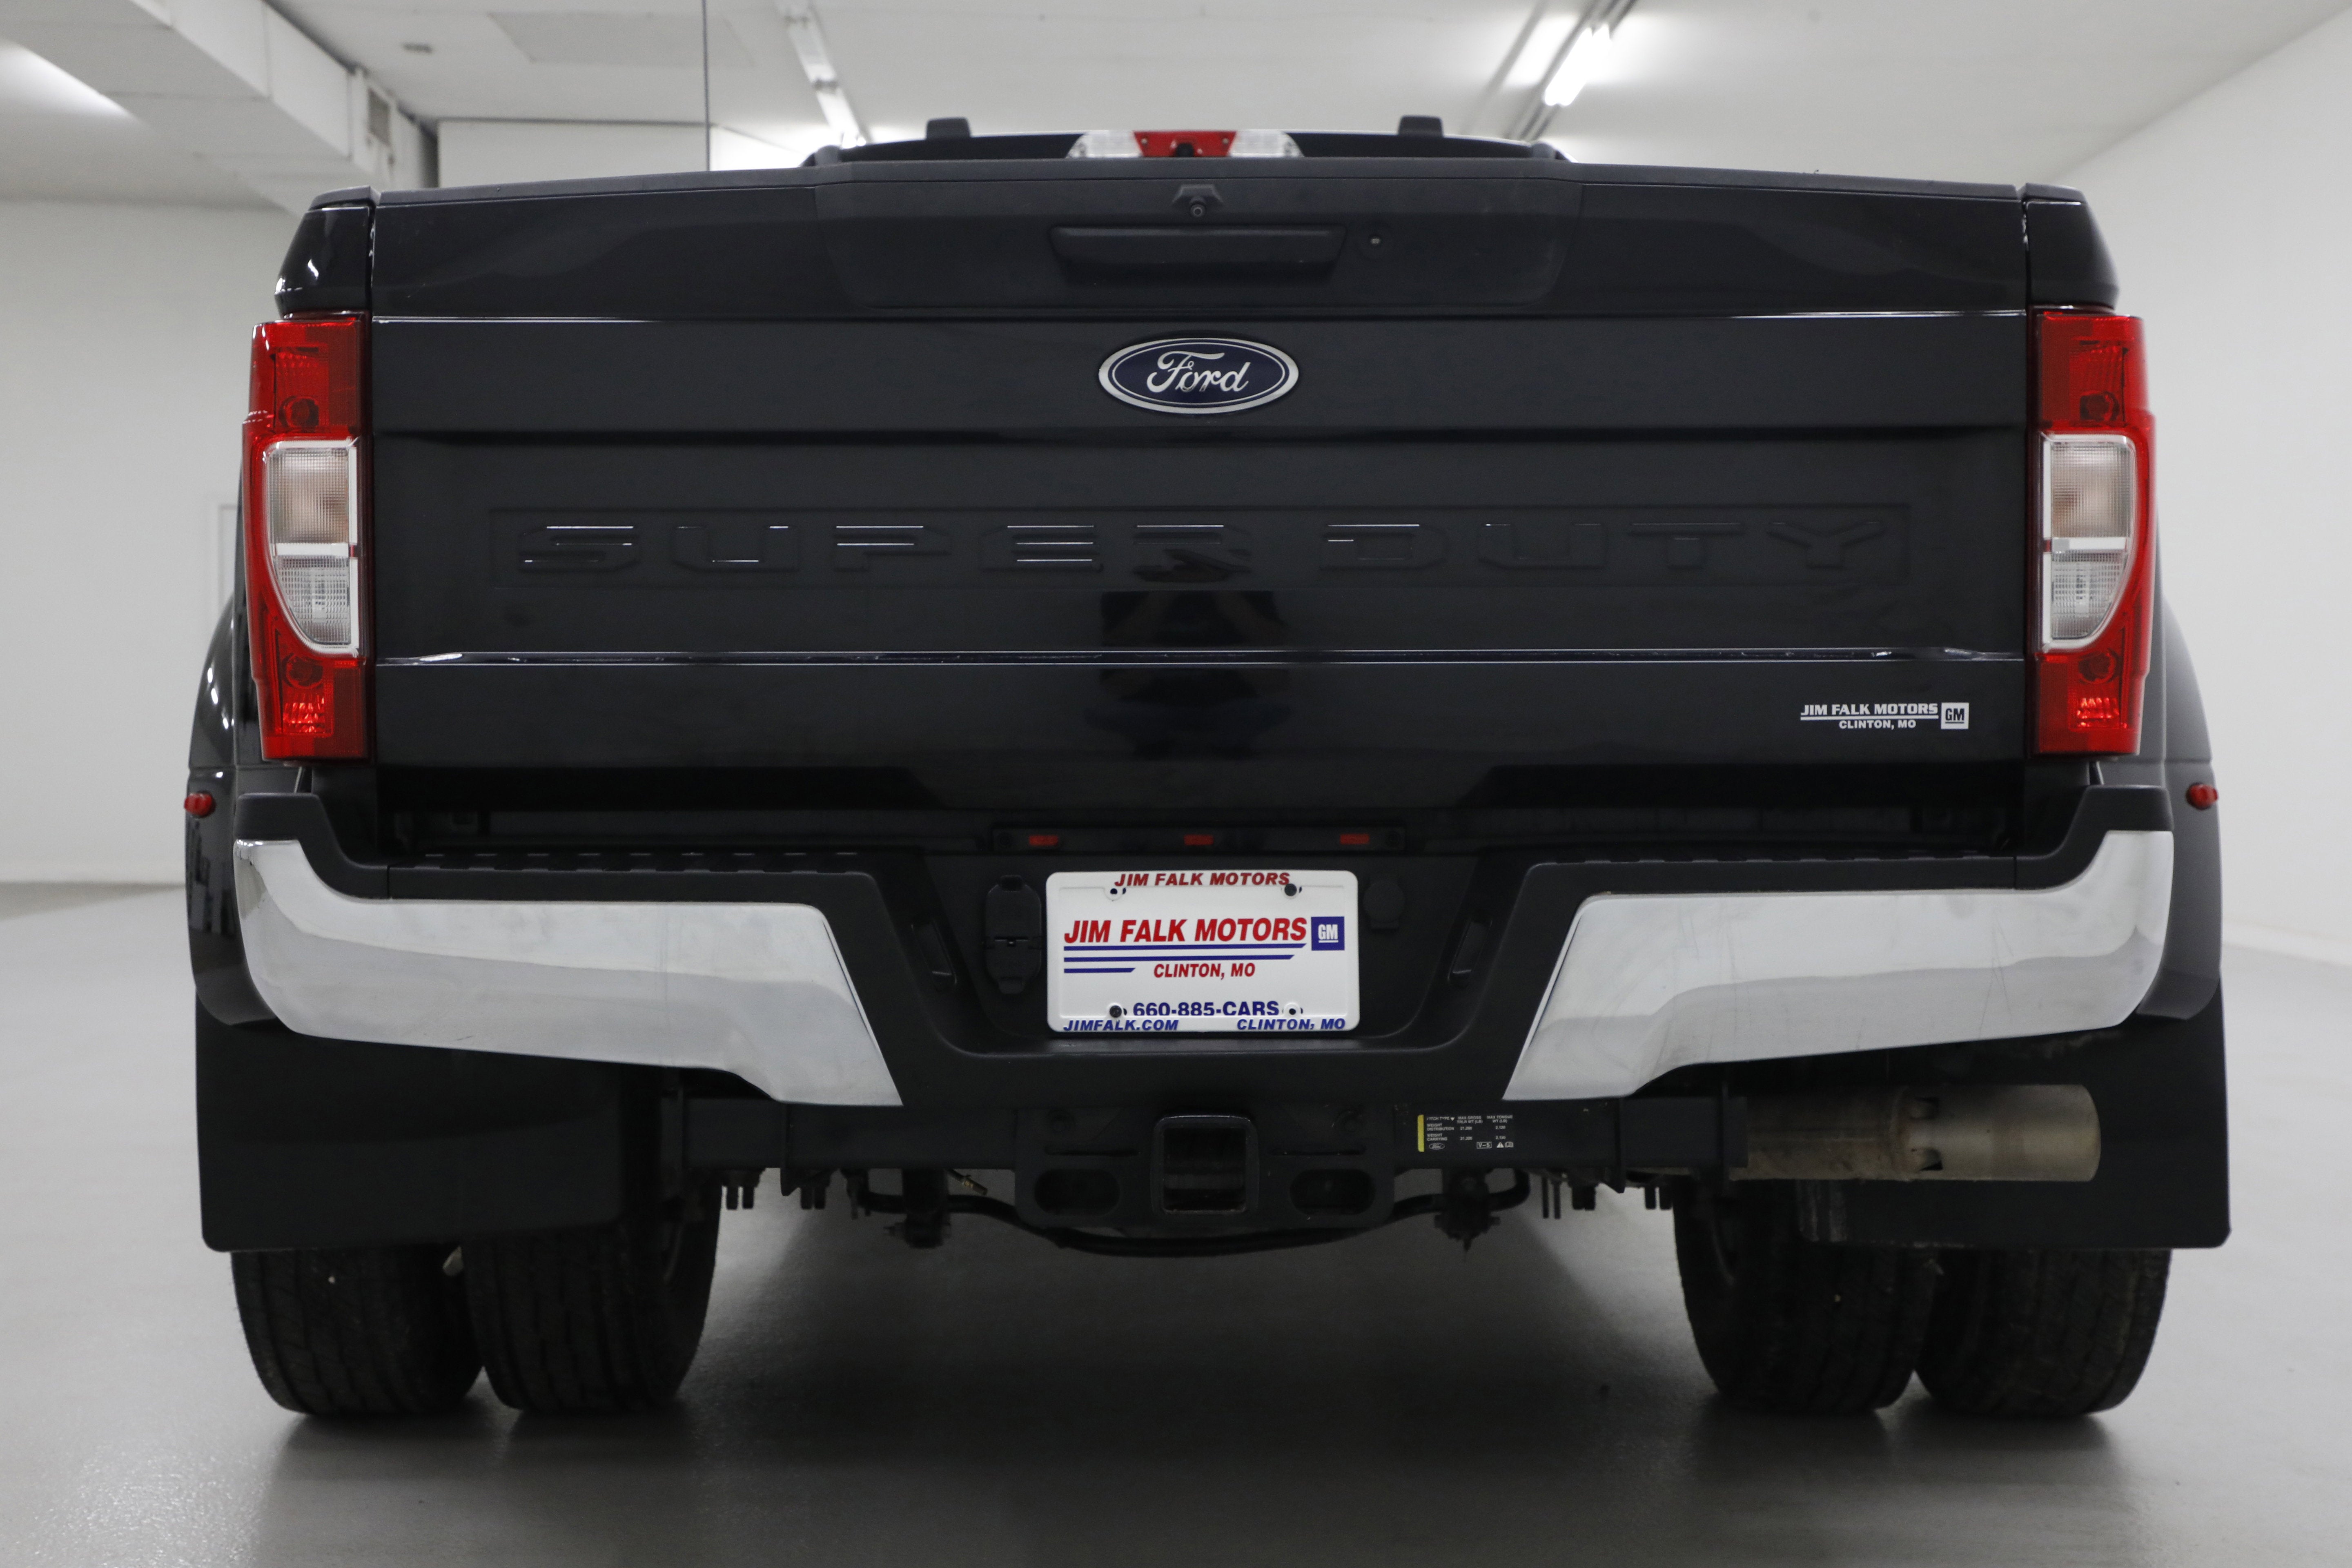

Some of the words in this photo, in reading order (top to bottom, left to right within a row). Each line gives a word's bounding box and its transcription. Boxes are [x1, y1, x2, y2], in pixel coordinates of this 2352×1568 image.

[1147, 351, 1251, 393] Ford
[519, 523, 1252, 574] SUPER
[1317, 520, 1886, 572] DUTY
[1800, 704, 1827, 715] JIM
[1832, 704, 1871, 715] FALK
[1874, 703, 1938, 715] MOTORS
[1945, 708, 1964, 721] GM
[1839, 720, 1895, 730] CLINTON,
[1898, 719, 1916, 728] MO
[1114, 874, 1149, 886] JIM
[1154, 873, 1203, 886] FALK
[1209, 872, 1290, 885] MOTORS
[1064, 920, 1111, 943] JIM
[1120, 919, 1187, 942] FALK
[1194, 918, 1307, 942] MOTORS
[1318, 924, 1338, 940] GM
[1154, 963, 1225, 980] CLINTON,
[1231, 963, 1256, 977] MO
[1133, 1001, 1279, 1016] 660-885-CARS
[1063, 1020, 1179, 1031] JIMFALK.COM
[1237, 1019, 1314, 1030] CLINTON,
[1321, 1018, 1345, 1029] MO
